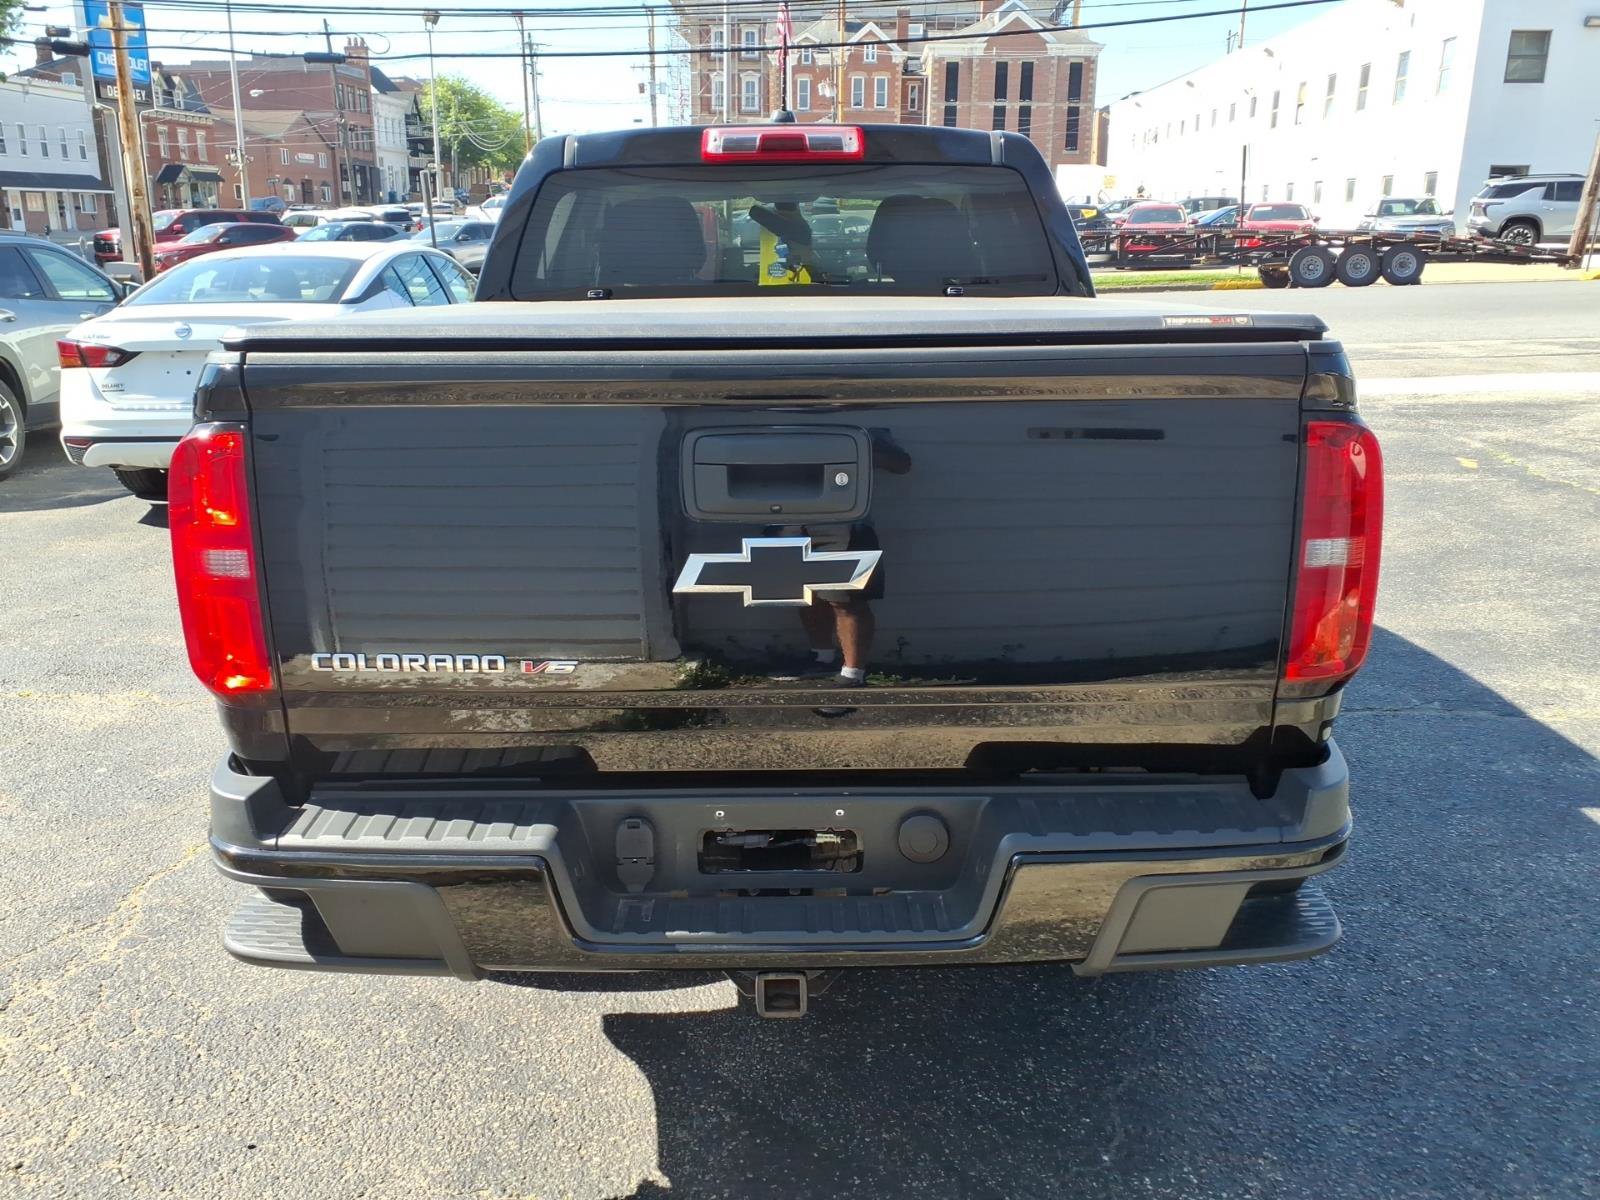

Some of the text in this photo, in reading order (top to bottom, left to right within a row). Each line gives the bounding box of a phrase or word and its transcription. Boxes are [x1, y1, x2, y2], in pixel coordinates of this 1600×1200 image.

[97, 51, 148, 72] CHEOLET
[106, 85, 146, 101] DEEY
[310, 653, 579, 674] COLORADO V6
